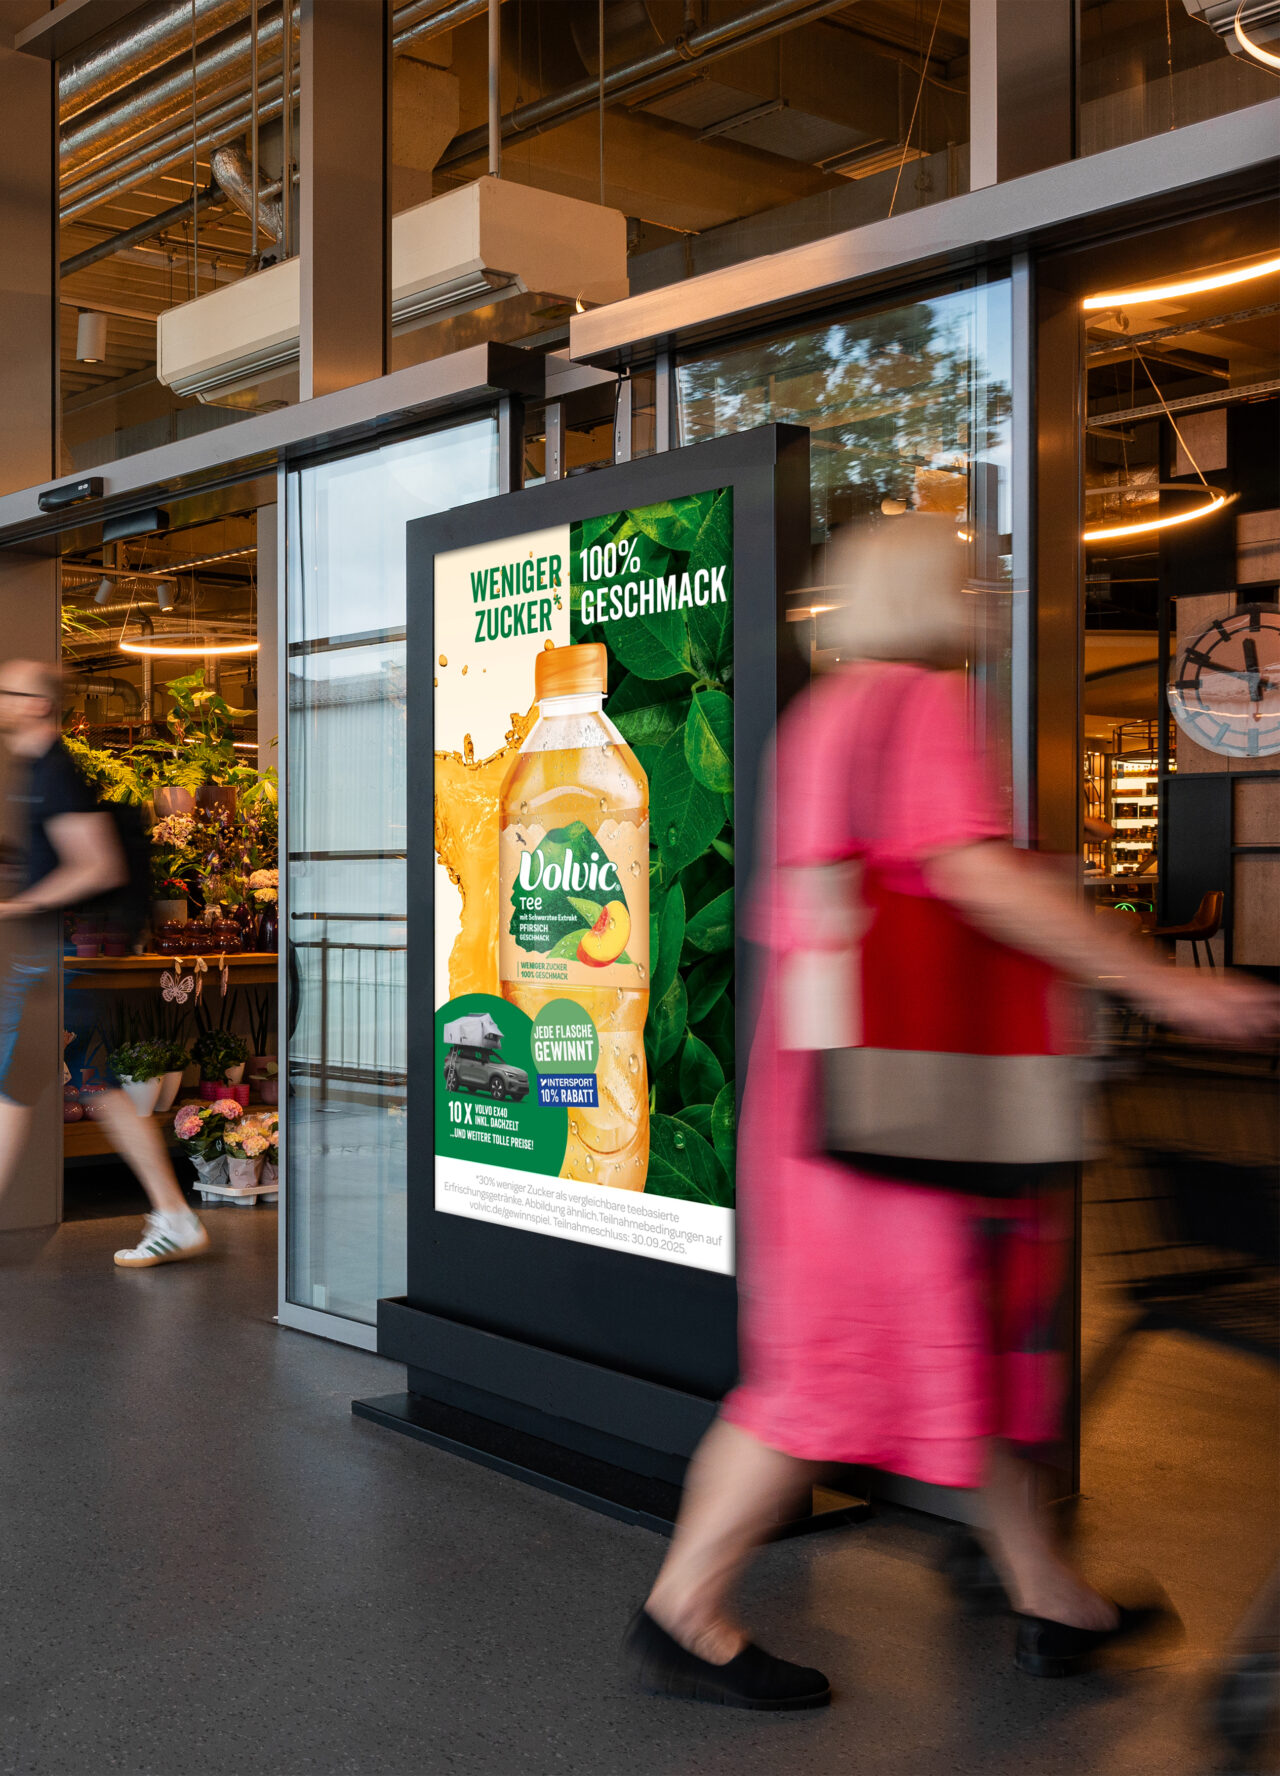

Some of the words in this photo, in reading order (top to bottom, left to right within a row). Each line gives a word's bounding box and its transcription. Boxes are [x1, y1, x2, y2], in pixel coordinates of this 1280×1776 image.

[580, 537, 641, 582] 100%
[470, 554, 562, 603] WENIGER
[581, 565, 727, 625] GESCHMACK
[519, 848, 618, 892] Volvic
[519, 923, 549, 933] PFIRSICH
[519, 934, 550, 942] GESCHMACK
[521, 961, 545, 970] WENIGER
[546, 962, 568, 972] ZUCKER
[521, 970, 535, 979] 100%
[536, 971, 569, 981] GESCHMACK
[534, 1025, 554, 1039] JEDE
[556, 1024, 593, 1039] FLASCHE
[534, 1040, 594, 1062] GEWINNT
[547, 1078, 594, 1087] INTERSPORT
[541, 1088, 560, 1103] 10%
[561, 1089, 594, 1103] RABATT
[448, 1100, 462, 1124] 10
[463, 1102, 473, 1125] X
[474, 1103, 493, 1116] VOLVO
[493, 1106, 508, 1118] EX40
[474, 1114, 490, 1127] INKL.
[490, 1117, 519, 1132] DACHZELT
[467, 1130, 491, 1143] WEITERE
[492, 1133, 510, 1147] TOLLE
[510, 1137, 534, 1150] PREISE!
[496, 1181, 526, 1194] weniger
[527, 1184, 555, 1198] Zucker
[556, 1190, 567, 1202] als
[568, 1193, 626, 1213] vergleichbare
[627, 1204, 680, 1223] teebasierte
[444, 1181, 524, 1207] Erfrischungsgetränke.
[524, 1197, 566, 1217] Abbildung
[566, 1206, 599, 1222] ähnlich.
[599, 1212, 705, 1243] Teilnahmebedingungen
[706, 1235, 723, 1247] auf
[469, 1200, 552, 1225] volvic.de/gewinnspiel.
[553, 1216, 630, 1242] Teilnahmeschluss:
[631, 1233, 688, 1255] 30.09.2025.
